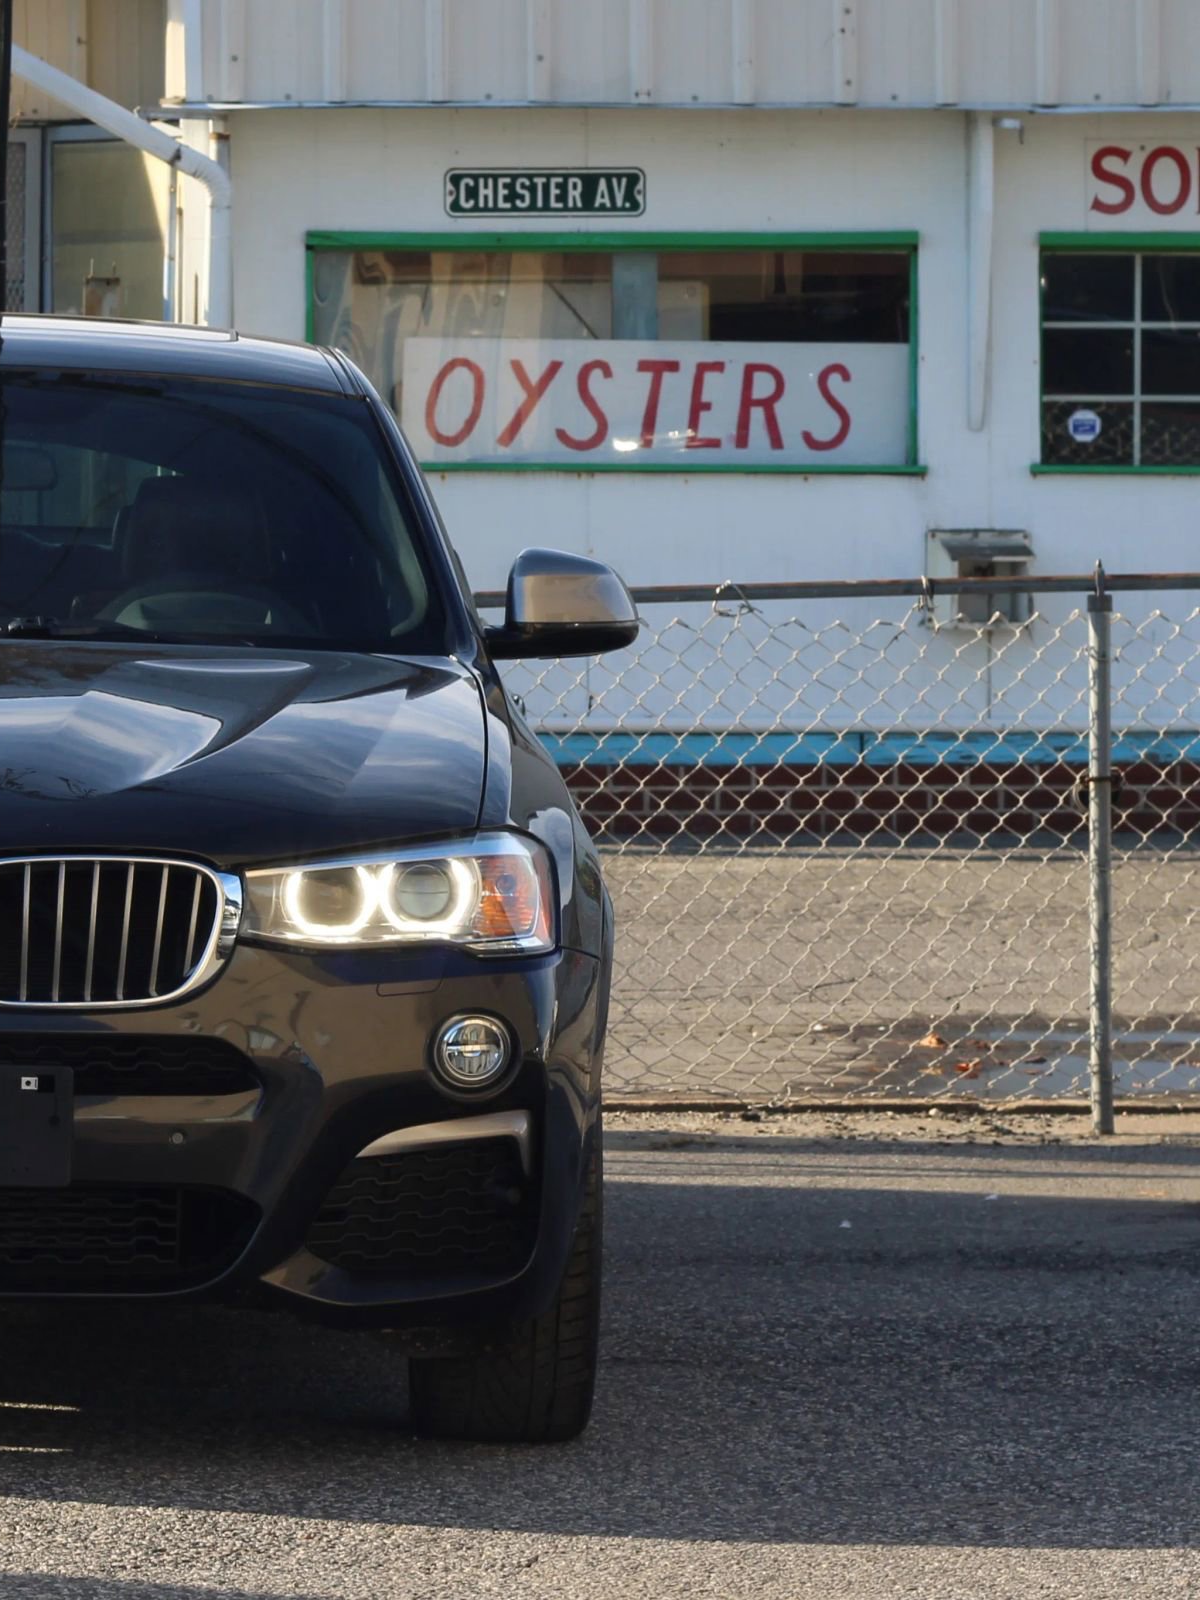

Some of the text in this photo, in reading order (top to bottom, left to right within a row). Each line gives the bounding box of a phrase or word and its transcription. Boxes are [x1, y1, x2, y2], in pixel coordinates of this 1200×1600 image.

[458, 176, 631, 209] CHESTER AV.
[1089, 145, 1200, 216] SO
[424, 356, 853, 452] OYSTERS
